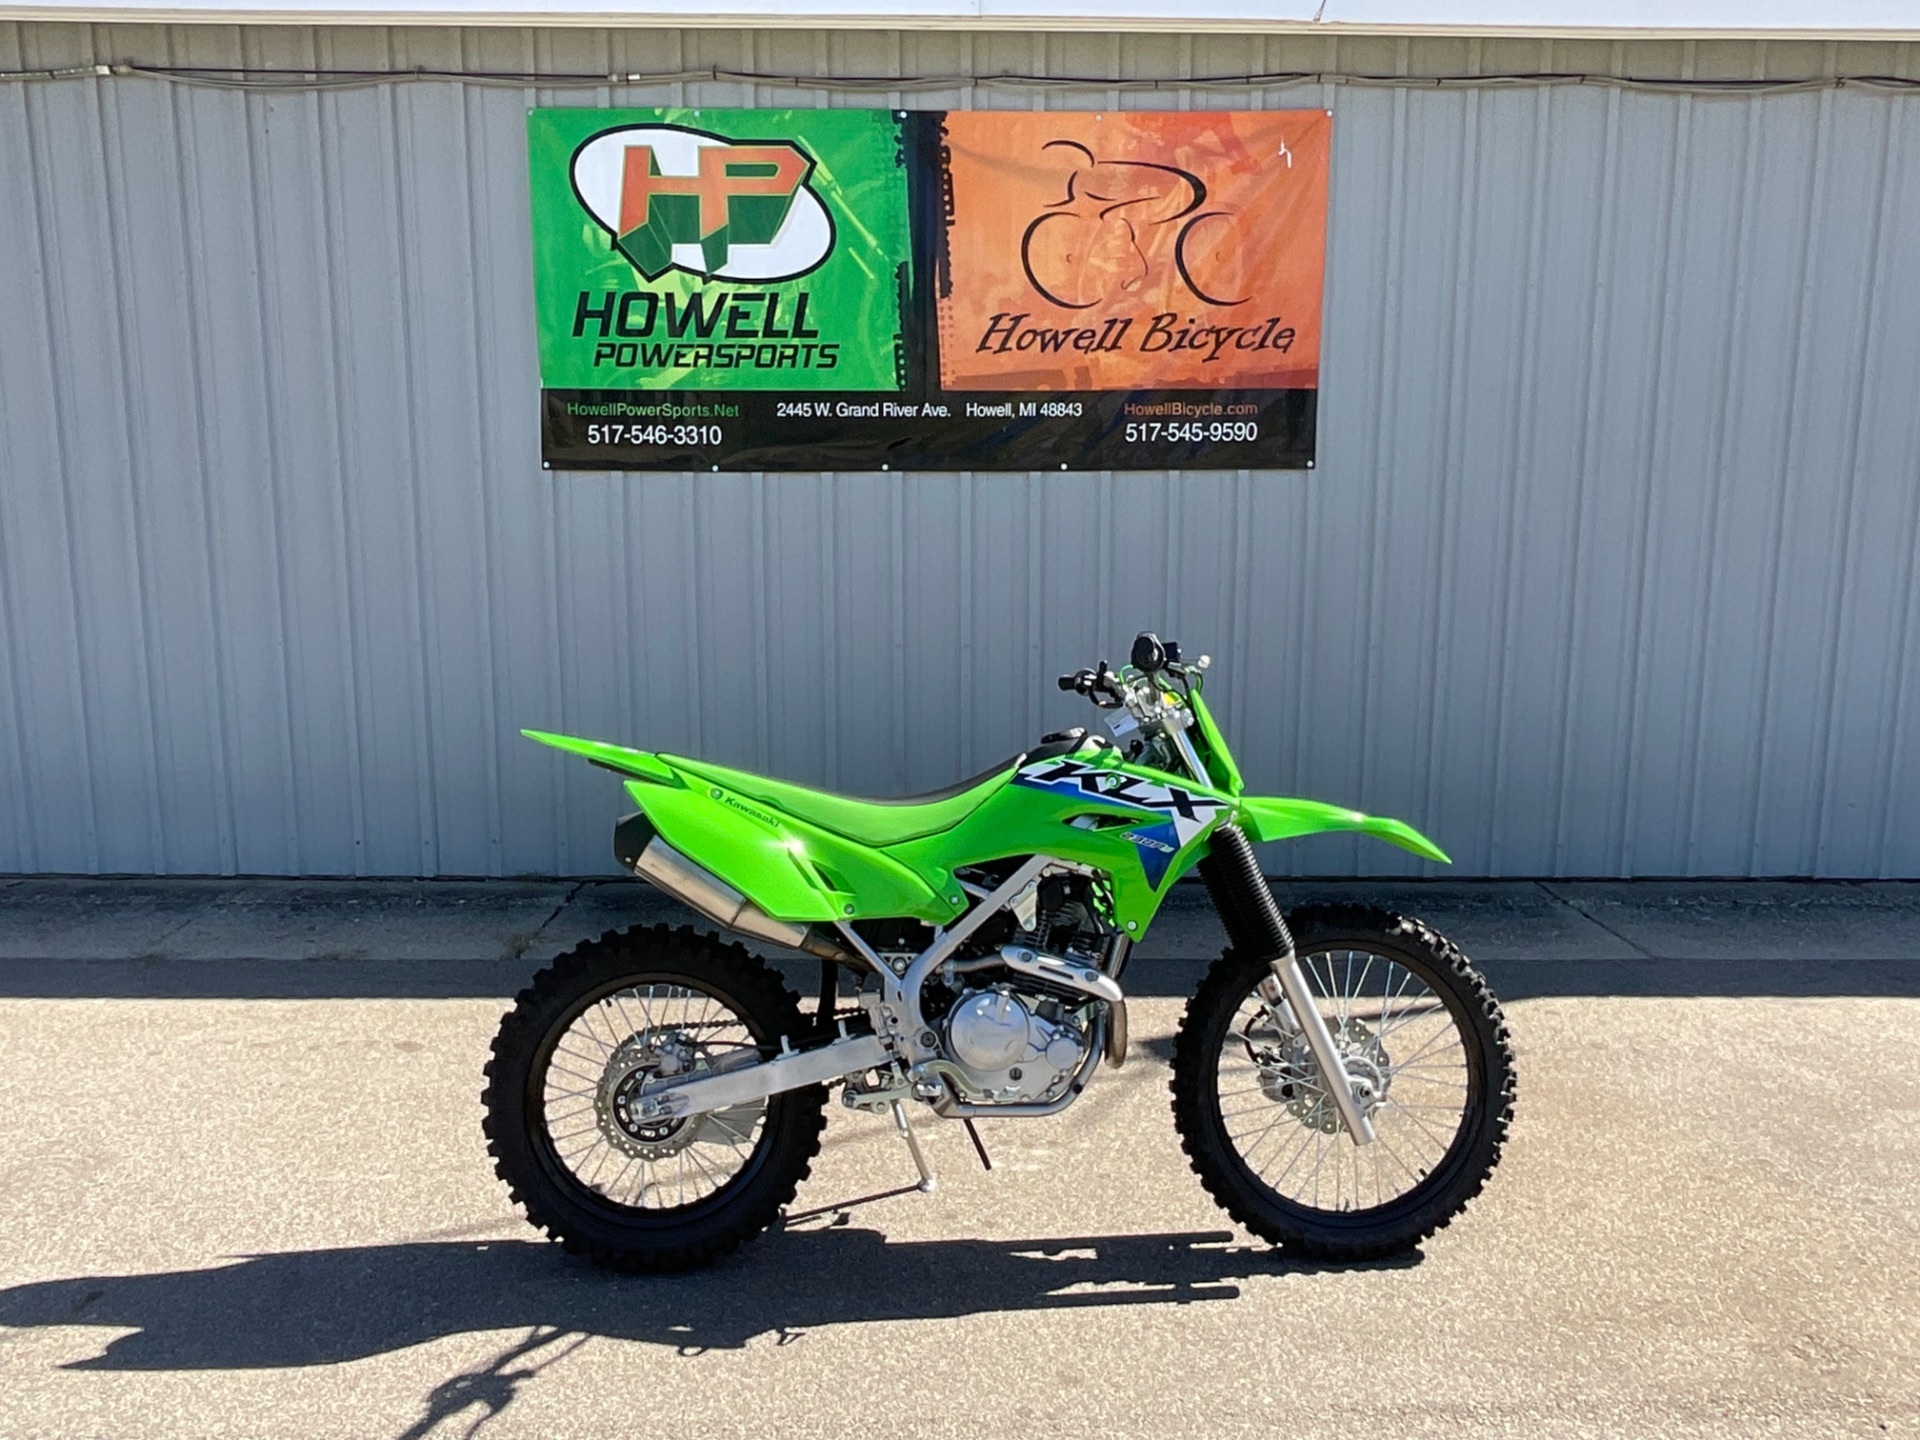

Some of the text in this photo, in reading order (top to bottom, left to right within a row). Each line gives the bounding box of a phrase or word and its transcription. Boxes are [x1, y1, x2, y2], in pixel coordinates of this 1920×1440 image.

[572, 290, 819, 339] HOWELL
[975, 311, 1296, 363] Howell Bicycle
[593, 343, 840, 369] POWERSPORTS
[567, 402, 740, 418] HowellPowerSports.Net
[776, 402, 1083, 419] 2445 W. Grand River Ave. Howell, MI 48843
[1124, 402, 1258, 417] HowellBicycle.com
[586, 424, 722, 445] 517-546-3310
[1124, 422, 1258, 442] 517-545-9590
[724, 796, 781, 828] Kawasaki
